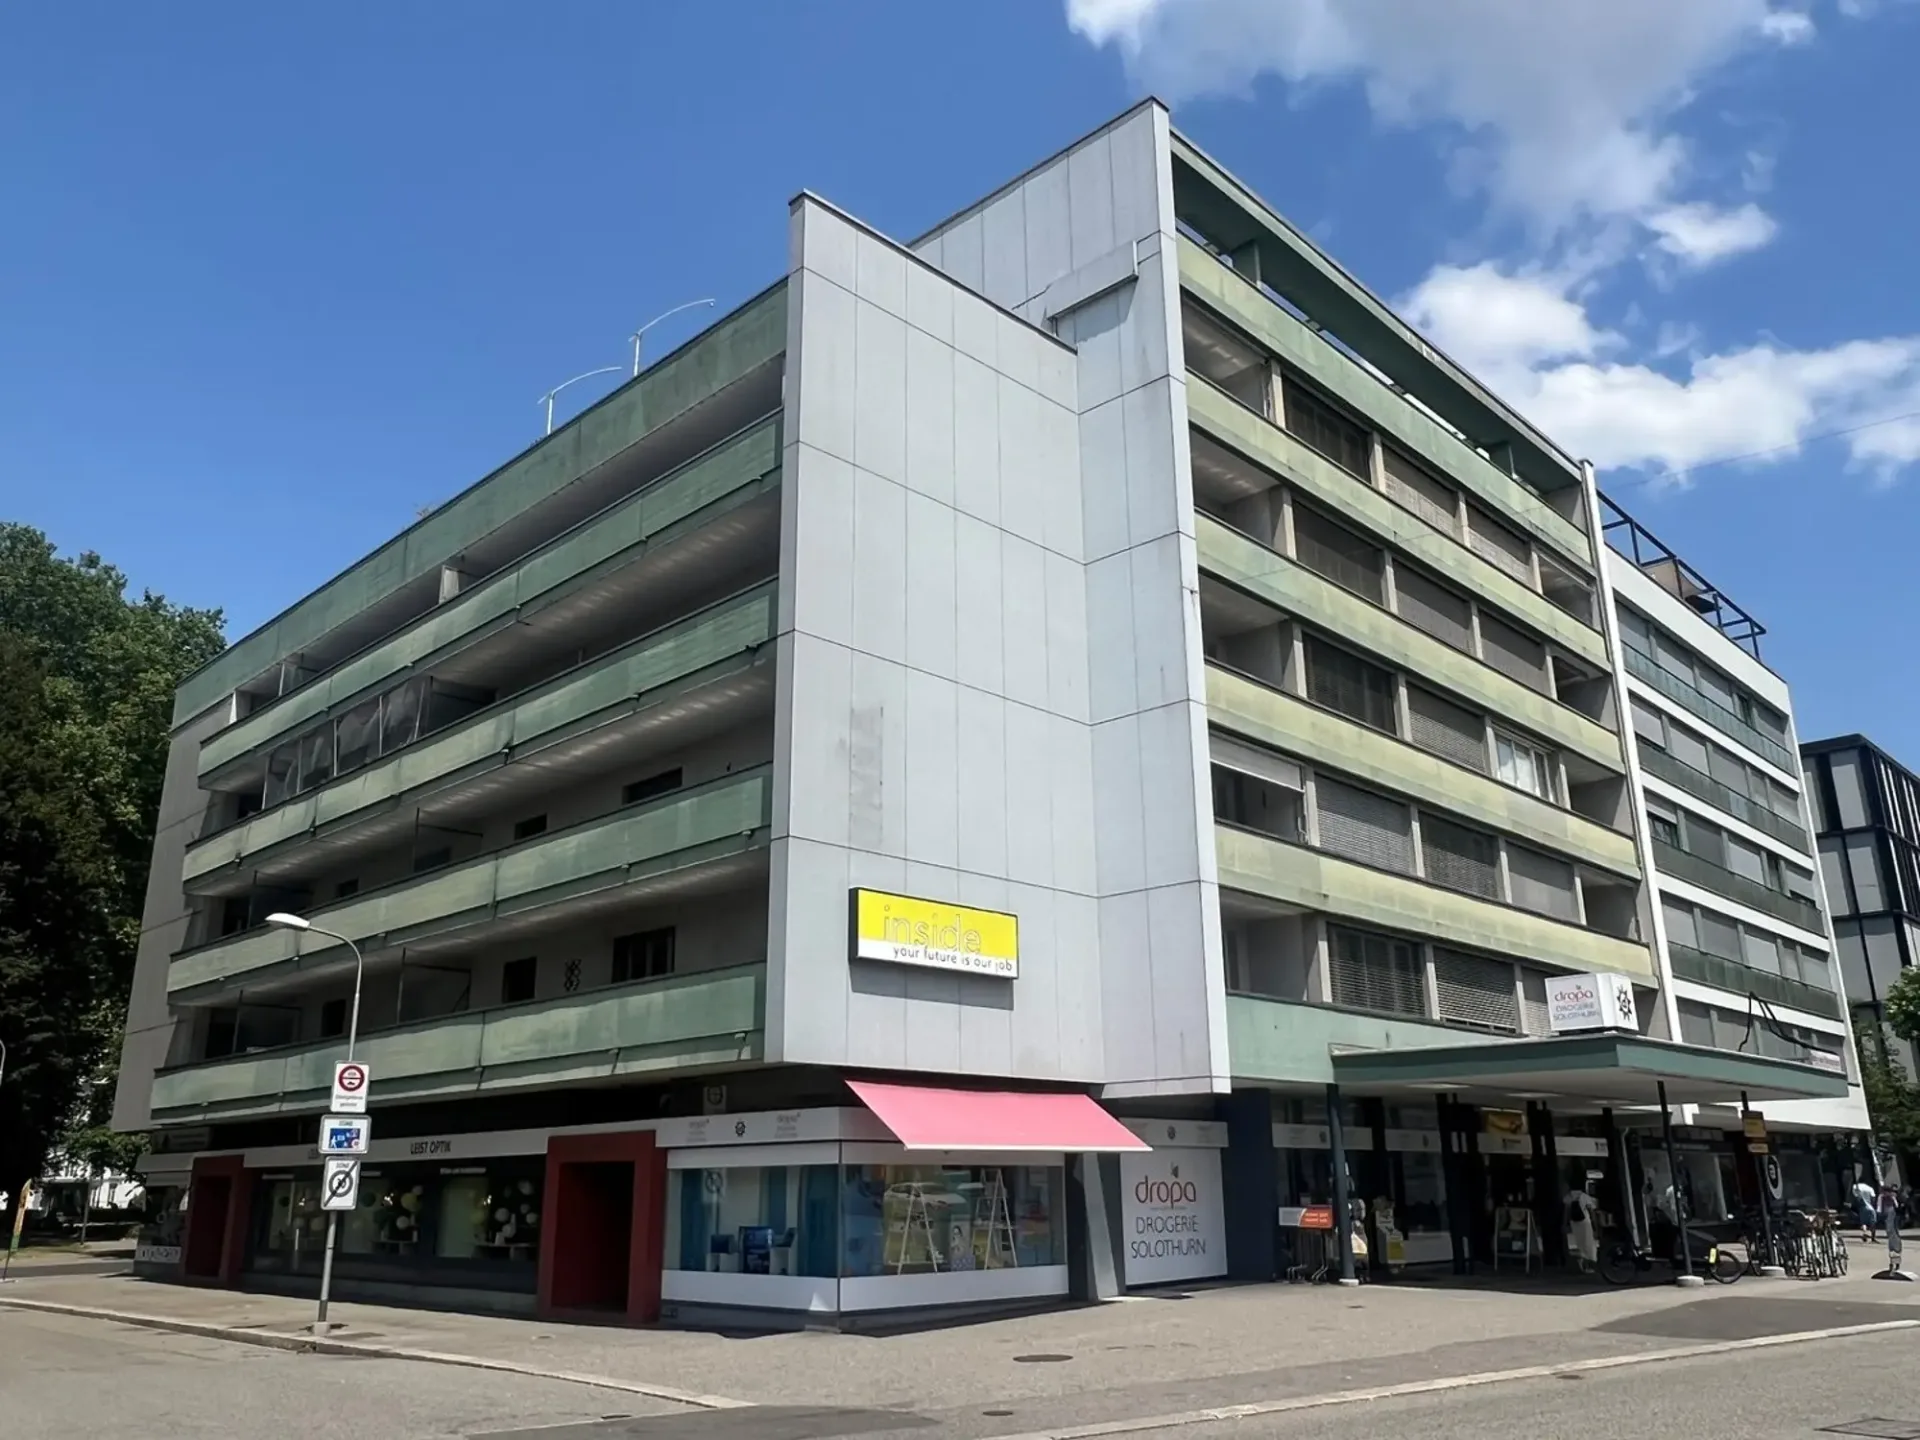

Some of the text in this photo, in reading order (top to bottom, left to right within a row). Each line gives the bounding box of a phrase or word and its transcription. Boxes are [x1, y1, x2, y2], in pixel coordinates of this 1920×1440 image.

[883, 904, 982, 955] inside
[893, 946, 1012, 973] your future is our job
[1554, 989, 1593, 1002] dropa
[410, 1140, 452, 1155] LEIST OPTIK
[1135, 1175, 1197, 1210] dropa
[1136, 1215, 1200, 1235] DROGERIE
[1130, 1238, 1207, 1260] SOLOTHURN
